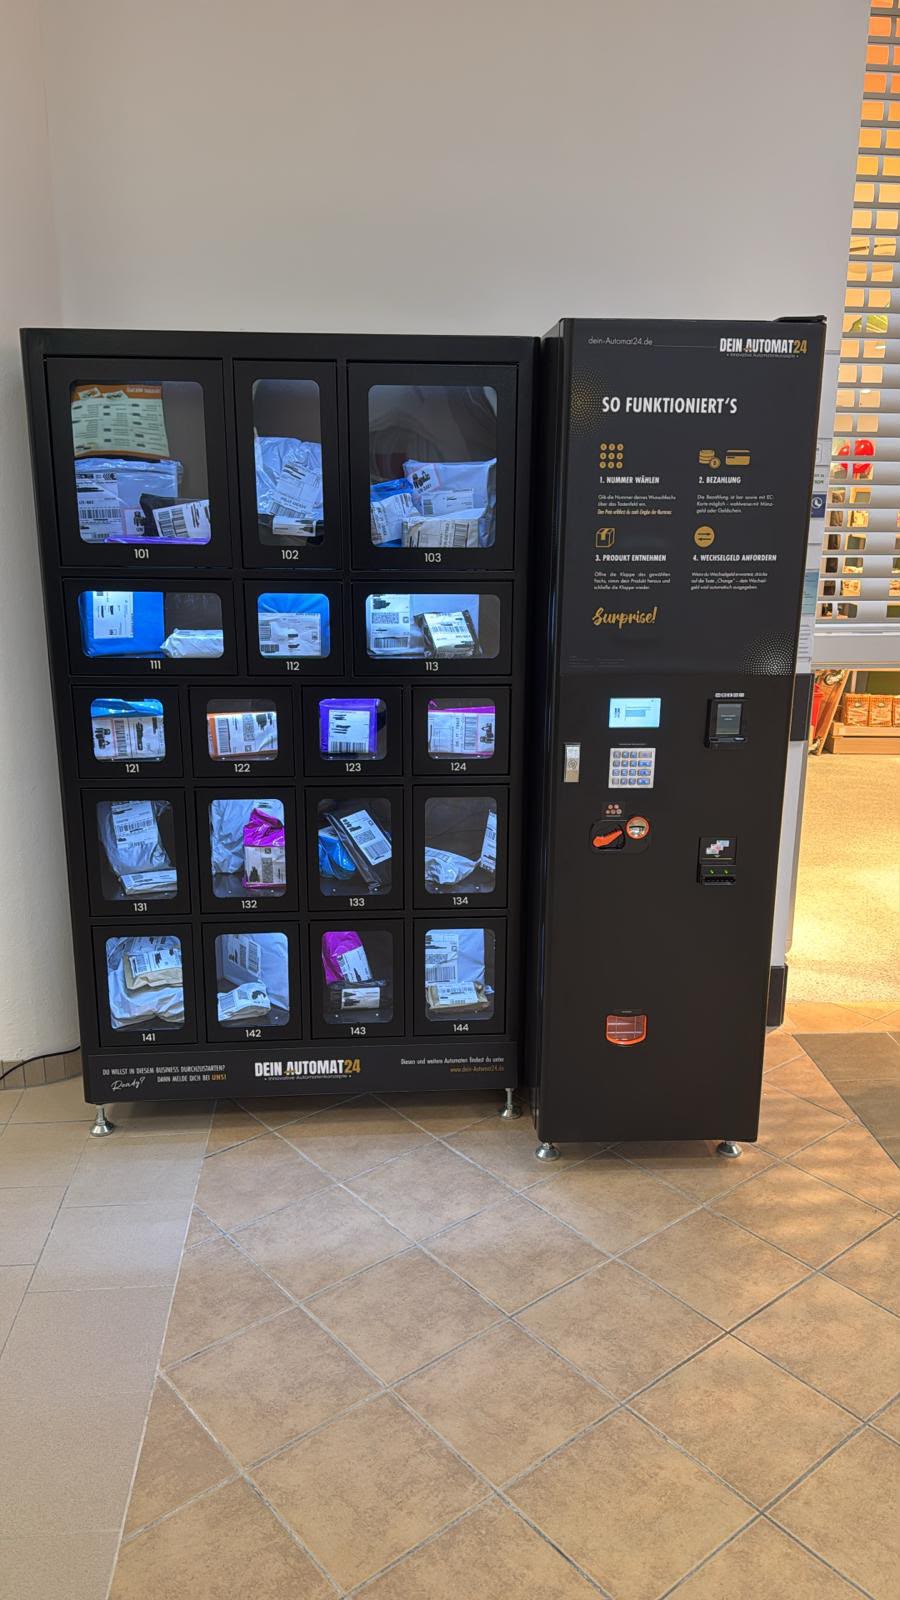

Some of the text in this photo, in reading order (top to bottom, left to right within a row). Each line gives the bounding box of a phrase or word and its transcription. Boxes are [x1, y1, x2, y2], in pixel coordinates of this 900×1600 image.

[588, 336, 653, 345] dein-Automat24.de
[720, 338, 808, 354] DEIN AUTOMAT24
[602, 396, 738, 414] SO FUNKTIONIERT'S
[599, 475, 660, 484] 1. NUMMER WÄHLEN
[698, 476, 742, 484] 2. BEZAHLUNG
[134, 548, 150, 559] 101
[281, 549, 299, 560] 102
[424, 552, 442, 563] 103
[595, 554, 667, 562] 3. PRODUKT ENTNEHMEN
[692, 554, 777, 562] 4. WECHSELGELD ANFORDERN
[592, 606, 659, 629] Surprise!
[149, 659, 161, 670] 111
[285, 661, 300, 671] 112
[425, 661, 439, 672] 113
[125, 763, 140, 773] 121
[233, 763, 251, 773] 122
[345, 762, 362, 772] 123
[450, 761, 467, 772] 124
[241, 899, 258, 909] 132
[349, 897, 365, 907] 133
[452, 896, 469, 906] 134
[133, 902, 148, 912] 131
[350, 1026, 367, 1036] 143
[453, 1023, 470, 1032] 144
[141, 1032, 156, 1042] 141
[245, 1028, 262, 1038] 142
[155, 1066, 180, 1074] BUSINESS
[254, 1059, 361, 1077] DEIN AUTOMAT24
[111, 1076, 146, 1091] Ready?
